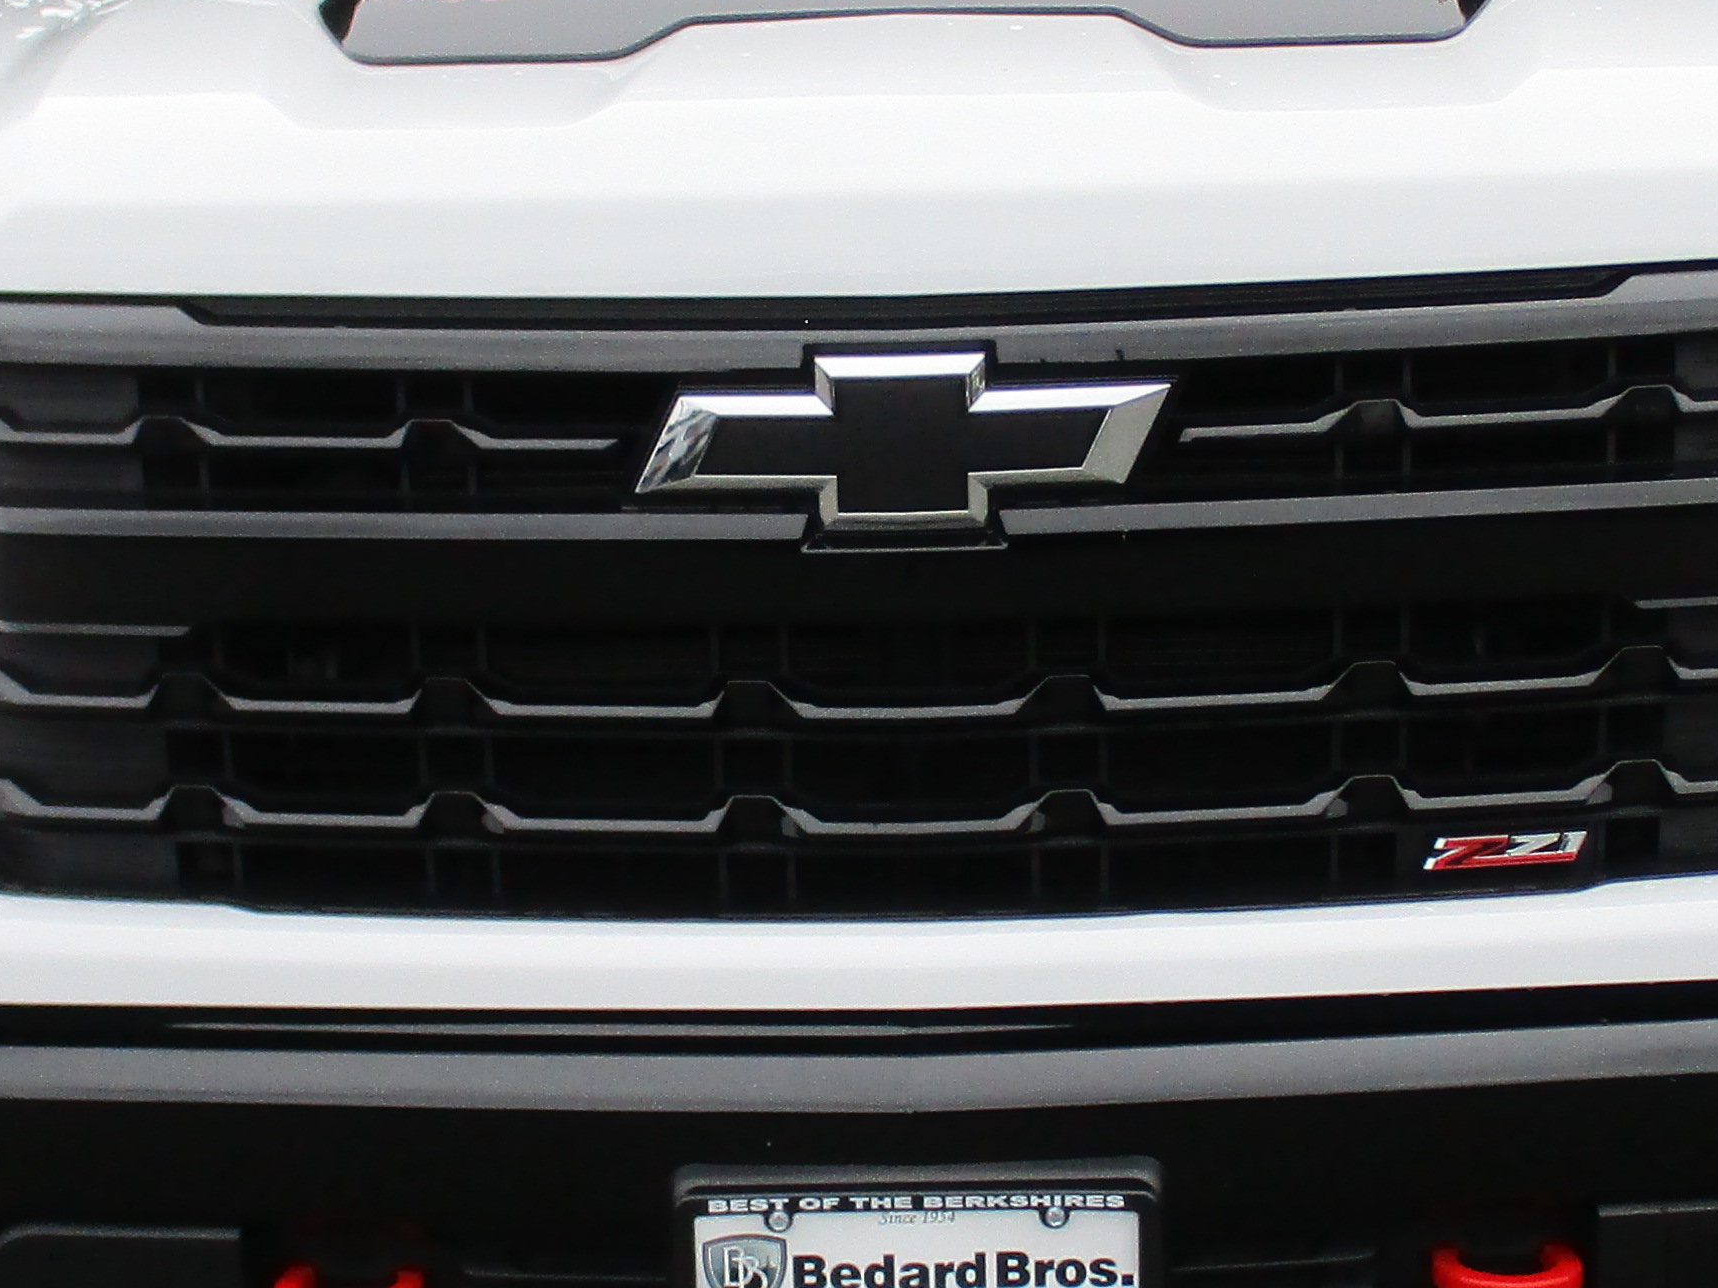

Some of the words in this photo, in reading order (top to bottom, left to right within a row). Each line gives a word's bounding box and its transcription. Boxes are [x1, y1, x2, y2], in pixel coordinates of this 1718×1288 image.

[1423, 830, 1588, 871] Z71
[707, 1198, 789, 1213] BEST
[798, 1197, 840, 1210] OF
[849, 1196, 913, 1210] THE
[923, 1194, 1126, 1209] BERKSHIRES
[877, 1212, 917, 1226] Since
[995, 1250, 1135, 1288] Bros.
